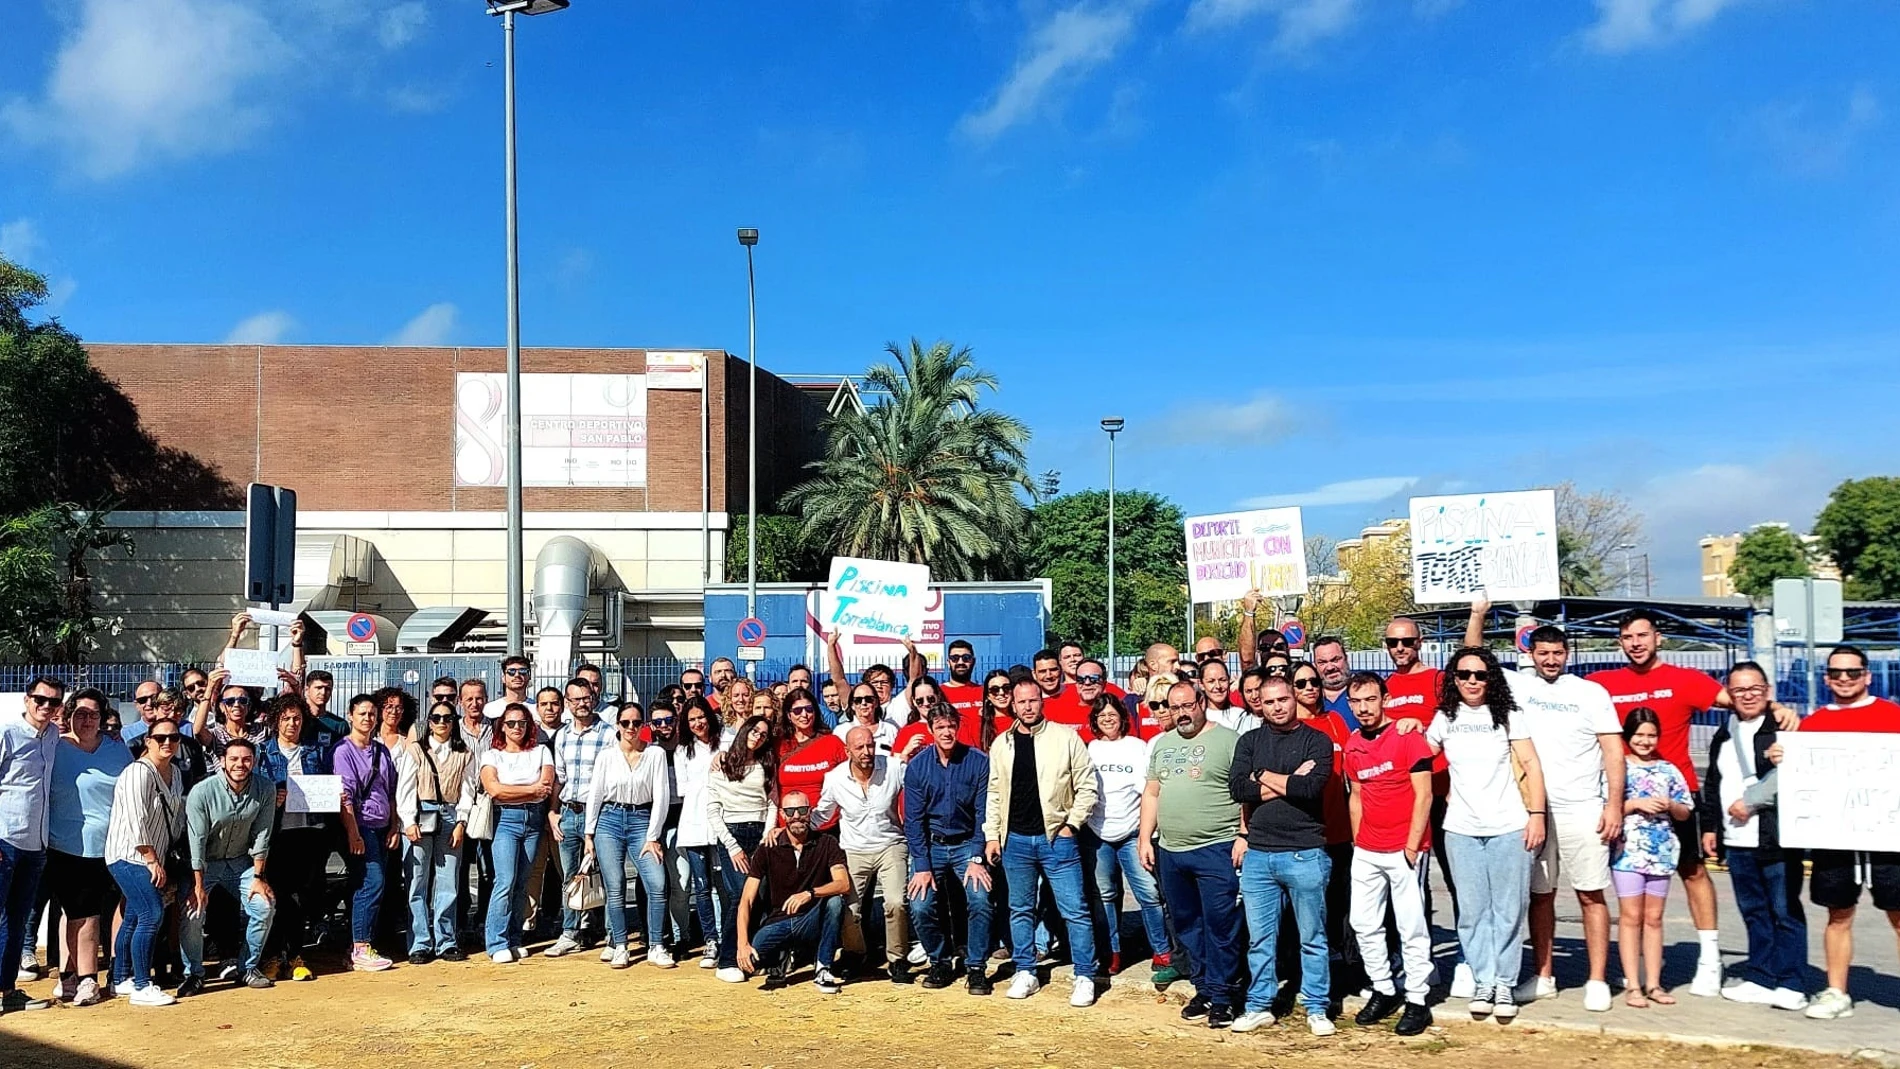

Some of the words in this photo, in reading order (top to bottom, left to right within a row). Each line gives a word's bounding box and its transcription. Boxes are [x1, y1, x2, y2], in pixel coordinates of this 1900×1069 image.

[531, 420, 575, 430] CENTRO
[580, 434, 603, 443] SAN
[606, 434, 642, 444] PABLO
[1192, 519, 1242, 539] DEPORTE
[1263, 534, 1292, 556] CON
[1195, 561, 1248, 581] DERECHO
